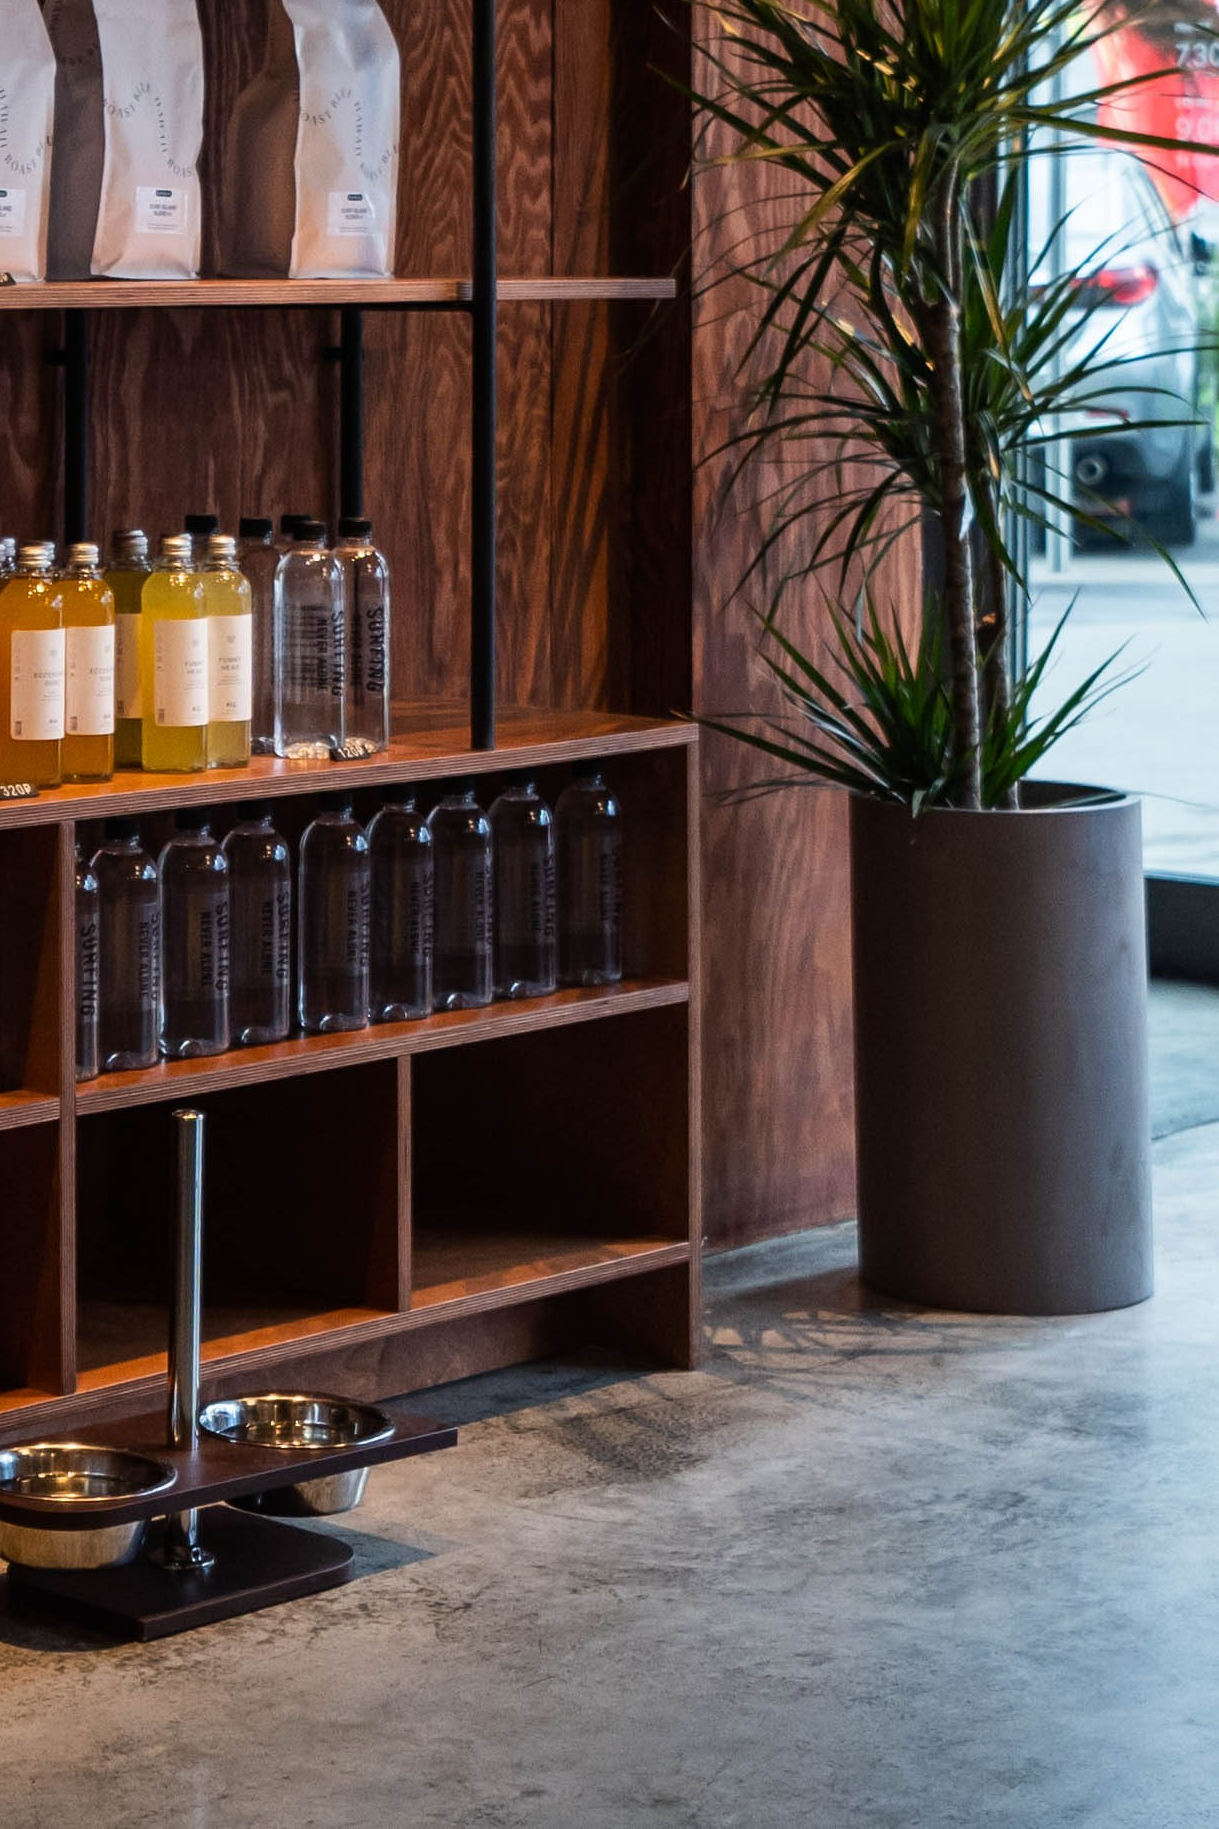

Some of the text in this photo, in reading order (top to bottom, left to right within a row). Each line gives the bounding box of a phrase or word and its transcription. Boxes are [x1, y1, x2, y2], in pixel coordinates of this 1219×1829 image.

[331, 610, 345, 697] SURFING
[366, 607, 385, 694] SURFING
[80, 923, 97, 1016] SURFING
[216, 901, 229, 991] SURFING
